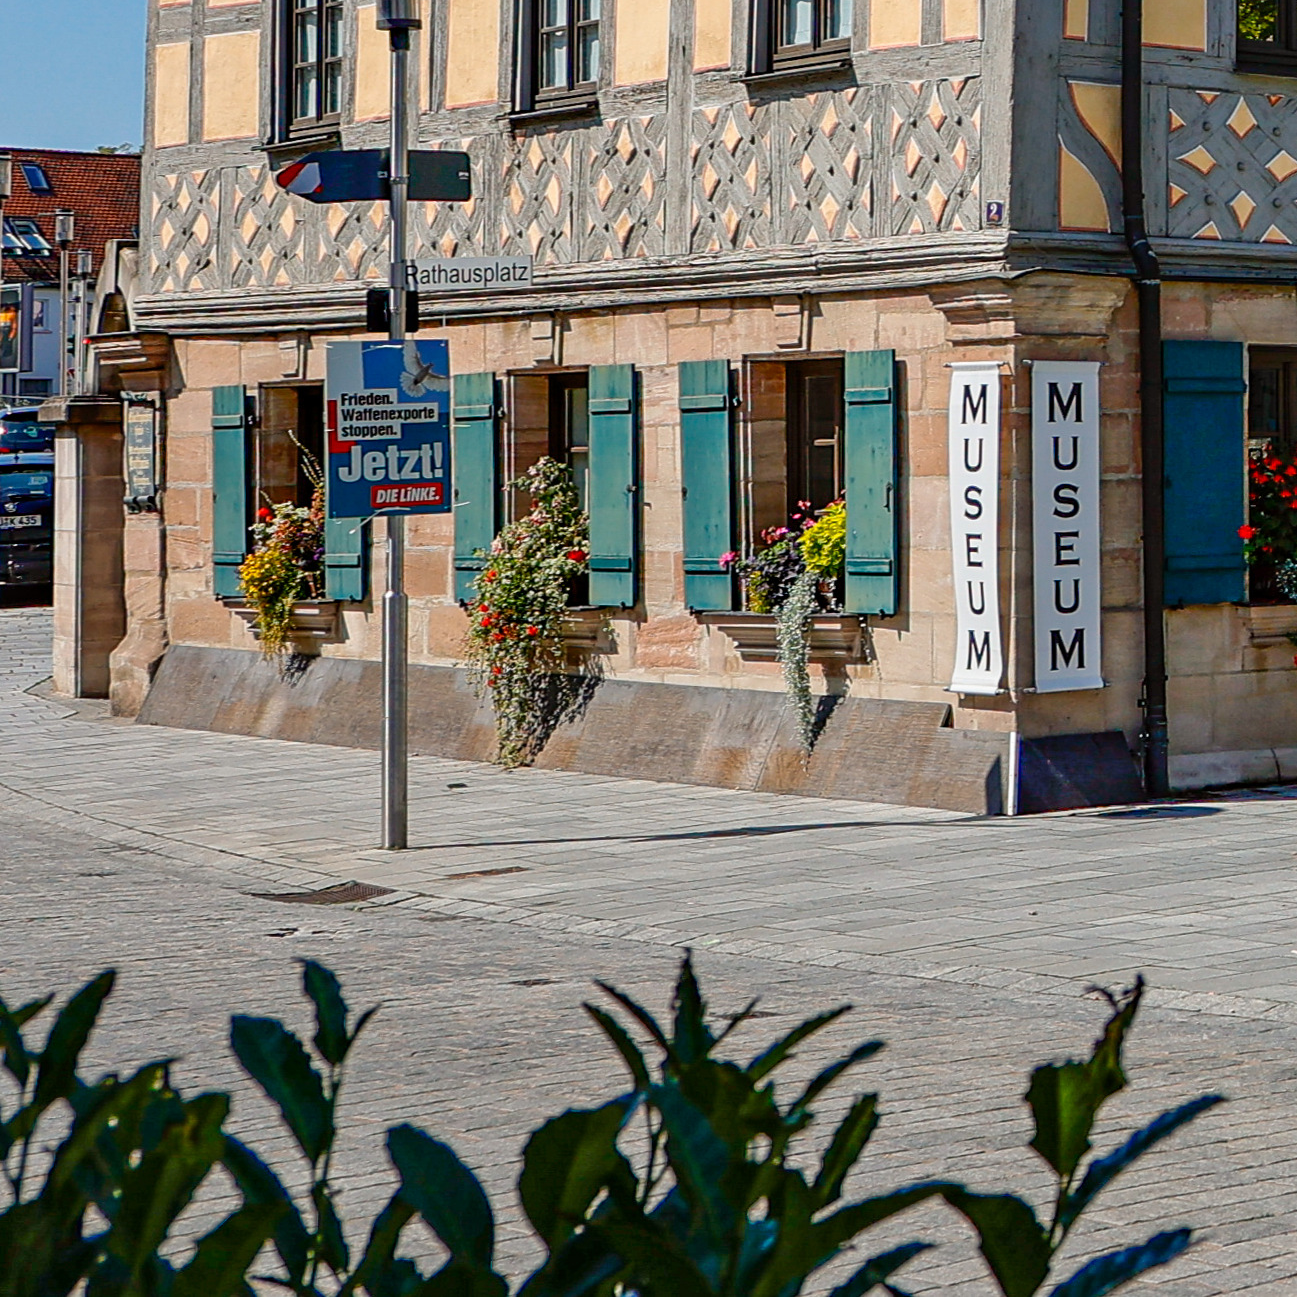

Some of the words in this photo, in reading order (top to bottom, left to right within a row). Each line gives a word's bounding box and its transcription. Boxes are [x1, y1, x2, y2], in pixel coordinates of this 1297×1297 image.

[990, 203, 999, 221] 2
[405, 262, 529, 287] Rathausplatz
[341, 393, 394, 406] Frieden.
[341, 406, 435, 421] Waffenexporte
[342, 424, 397, 437] stoppen.
[338, 442, 443, 482] Jetzt!
[376, 488, 398, 503] DIE
[961, 383, 991, 672] MUSEUM
[1048, 382, 1085, 671] MUSEUM
